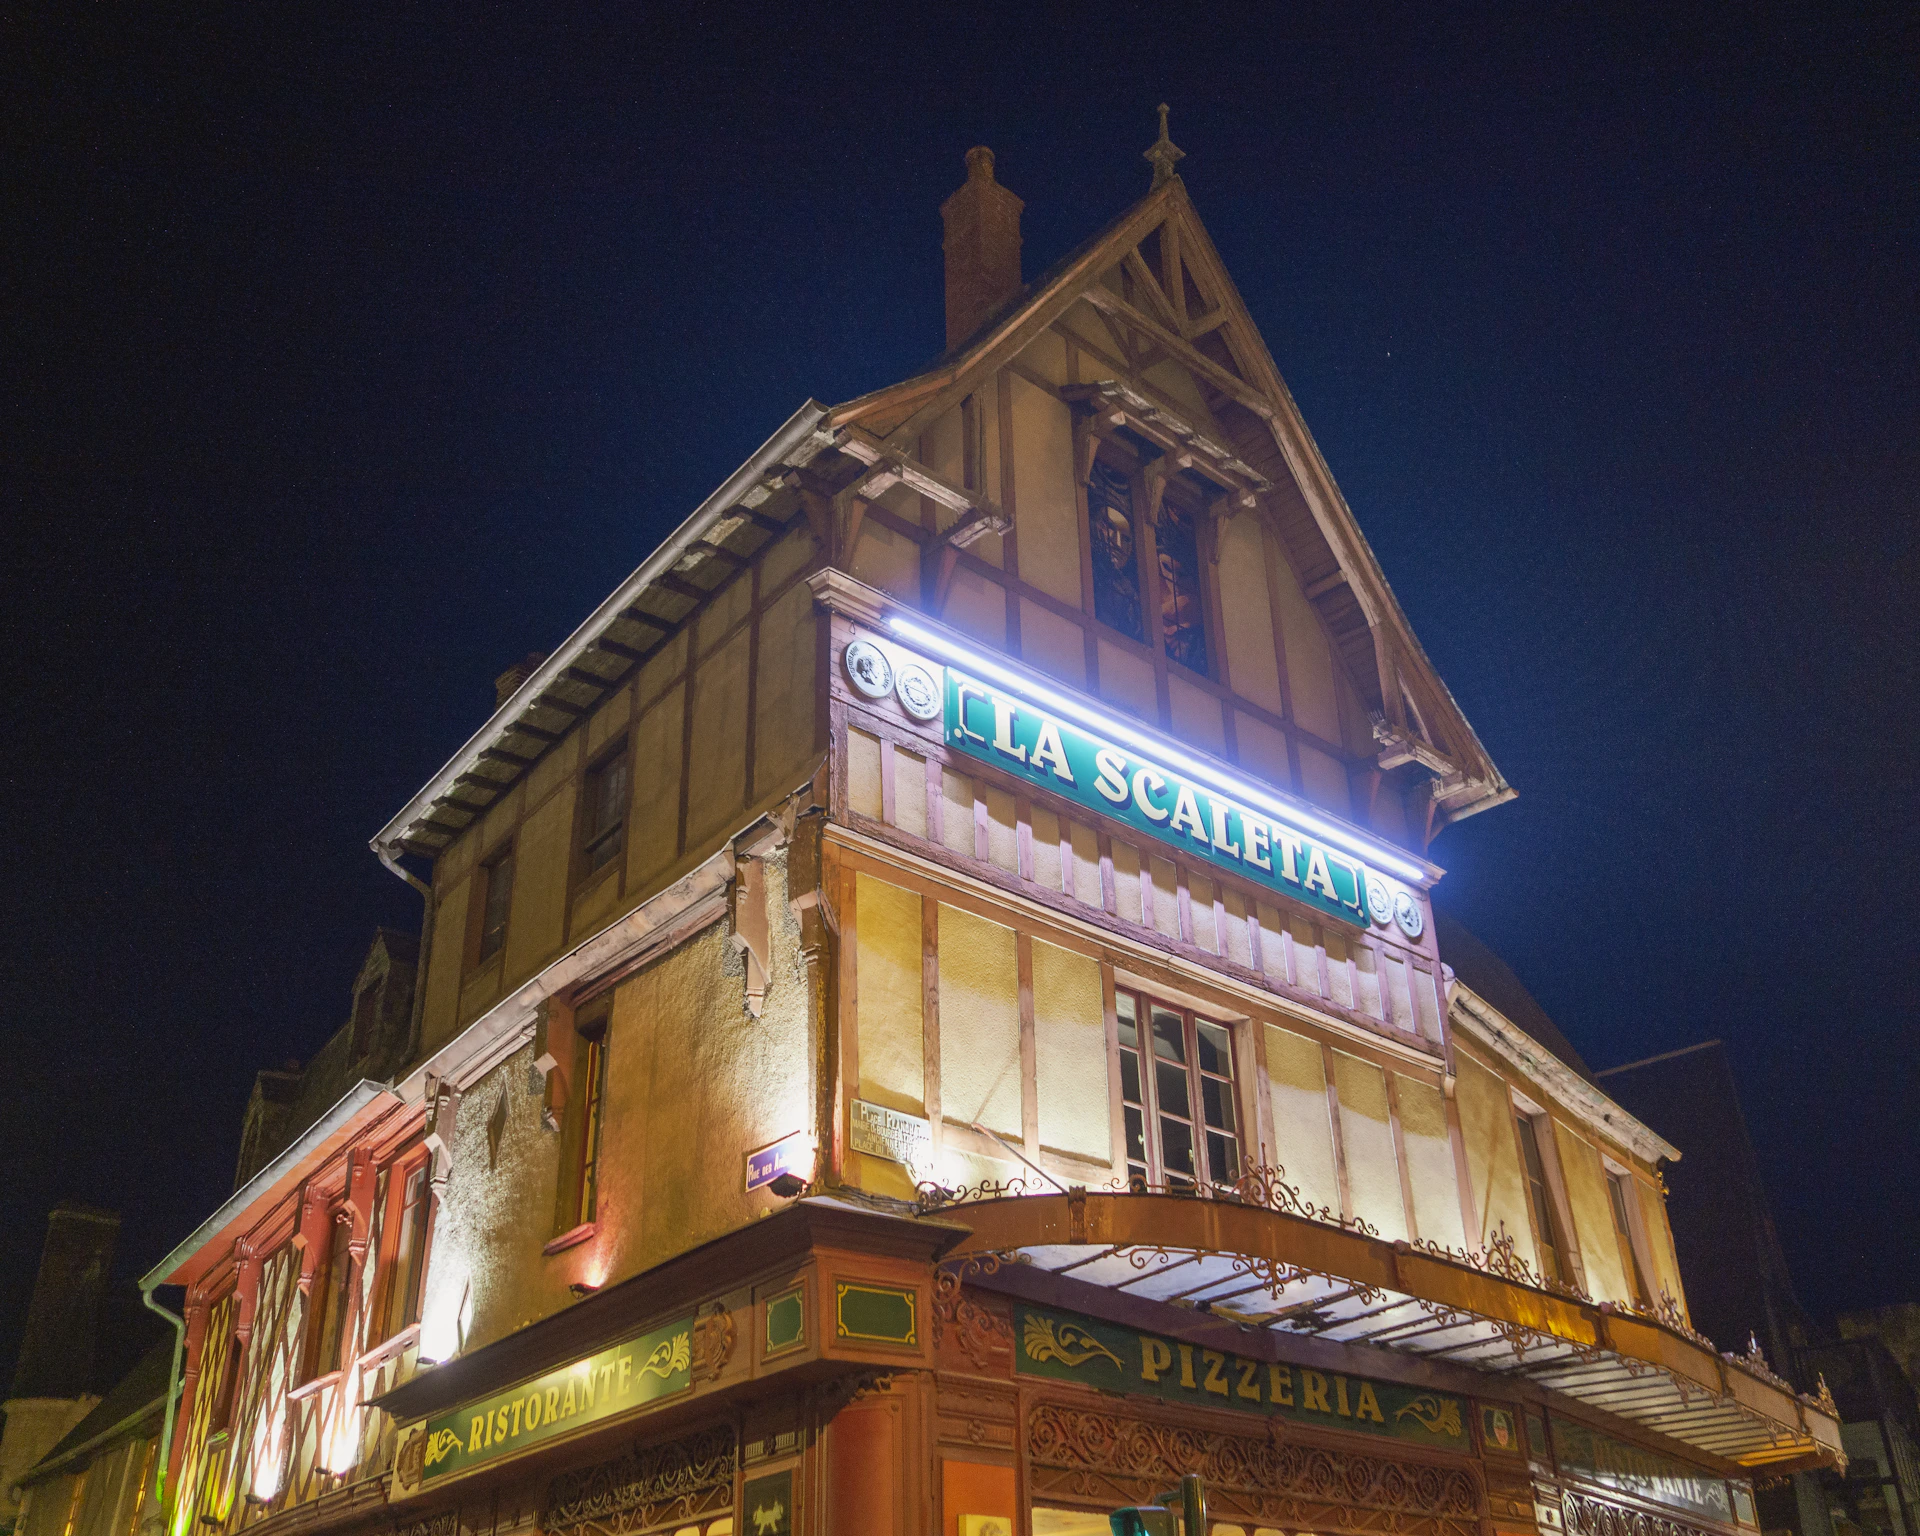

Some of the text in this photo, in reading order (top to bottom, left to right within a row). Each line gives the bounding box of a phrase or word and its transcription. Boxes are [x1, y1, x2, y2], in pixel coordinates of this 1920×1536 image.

[992, 695, 1338, 902] LA SCALETA
[854, 1138, 874, 1151] PLACE
[875, 1144, 884, 1153] DU
[467, 1354, 634, 1453] RISTORANTE
[1138, 1334, 1385, 1423] PIZZERIA
